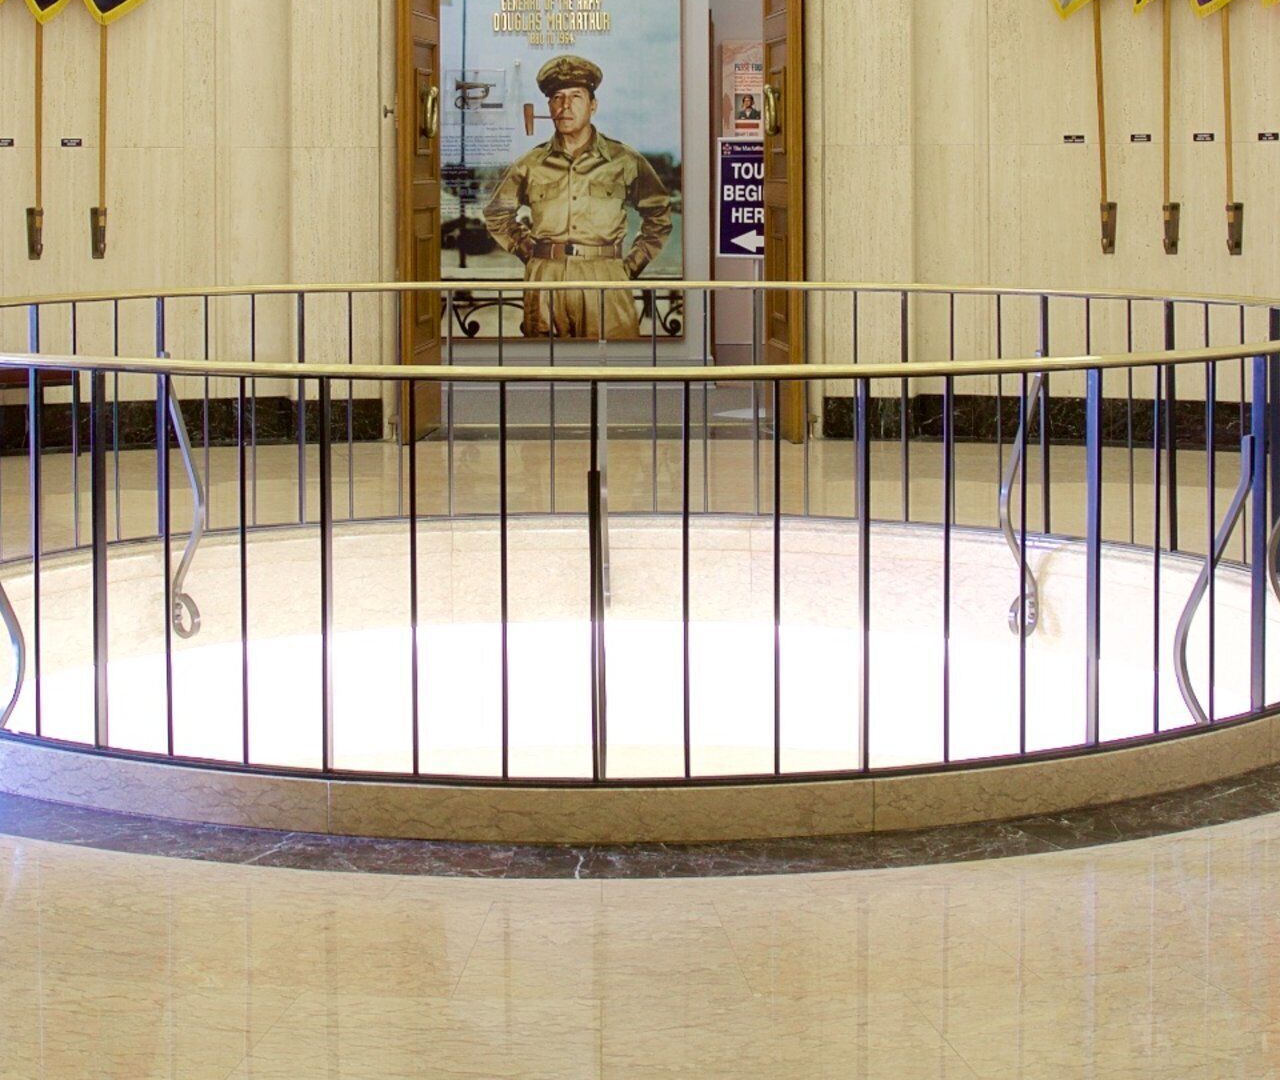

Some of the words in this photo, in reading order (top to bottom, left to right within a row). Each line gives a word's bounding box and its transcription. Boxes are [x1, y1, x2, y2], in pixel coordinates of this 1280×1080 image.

[493, 12, 541, 32] DOUGLAS
[731, 162, 764, 179] TOU
[731, 207, 764, 224] HER
